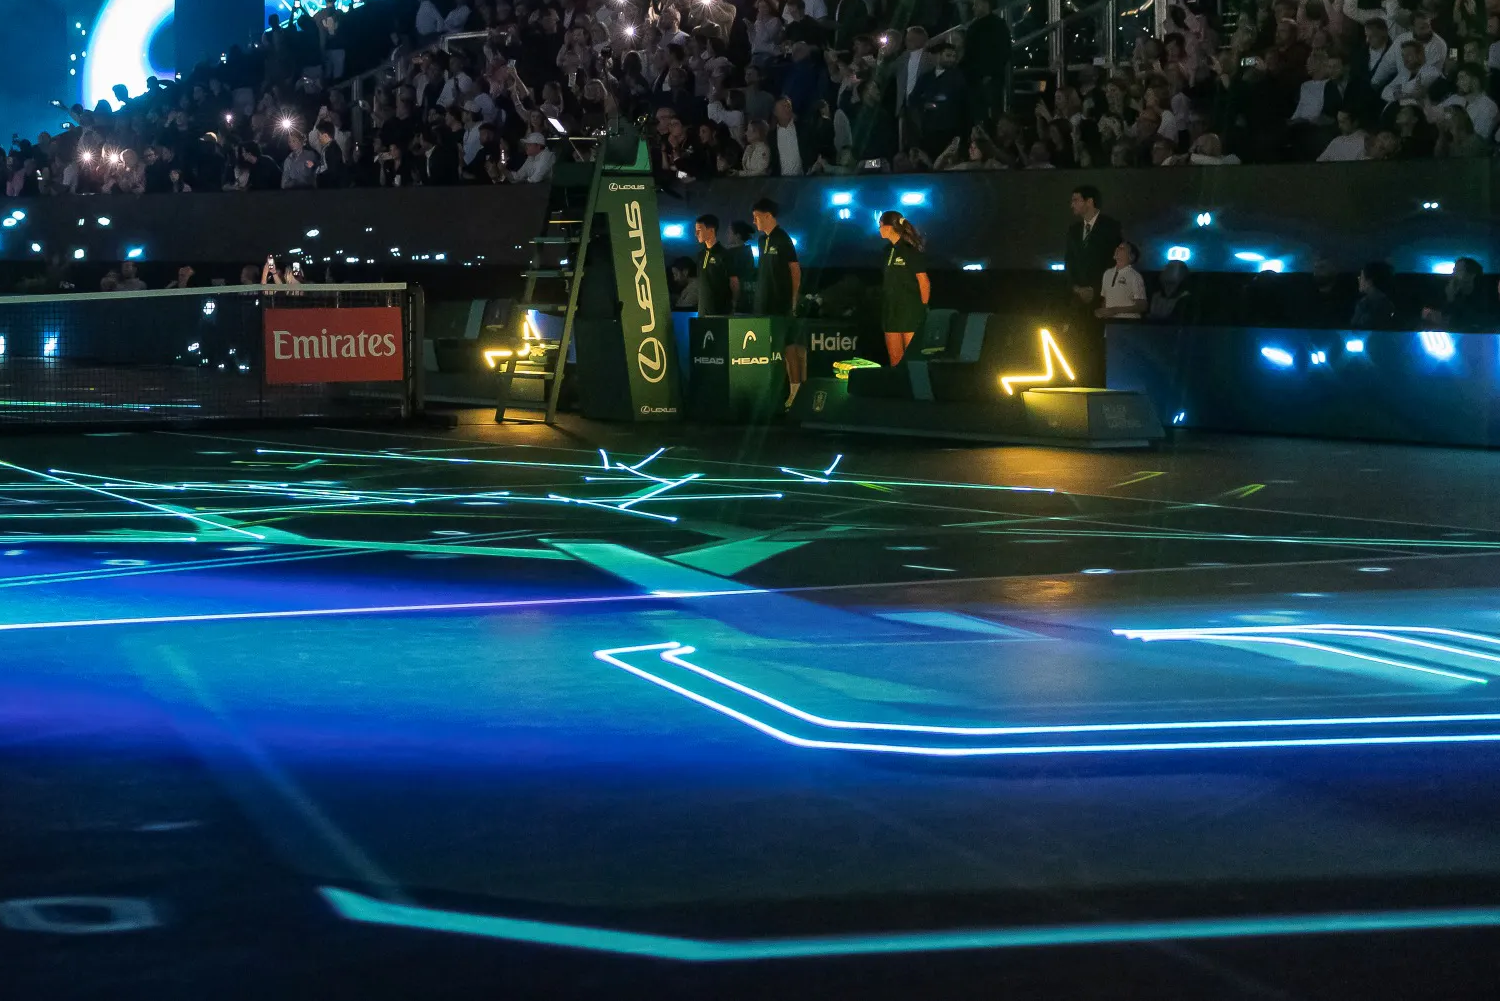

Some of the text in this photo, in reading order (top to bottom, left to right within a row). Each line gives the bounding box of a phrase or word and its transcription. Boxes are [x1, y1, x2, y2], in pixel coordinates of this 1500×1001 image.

[624, 200, 656, 334] LEXUS
[273, 328, 396, 360] Emirates
[811, 332, 859, 352] Haier
[694, 357, 725, 365] HEAD
[731, 357, 770, 365] HEAD
